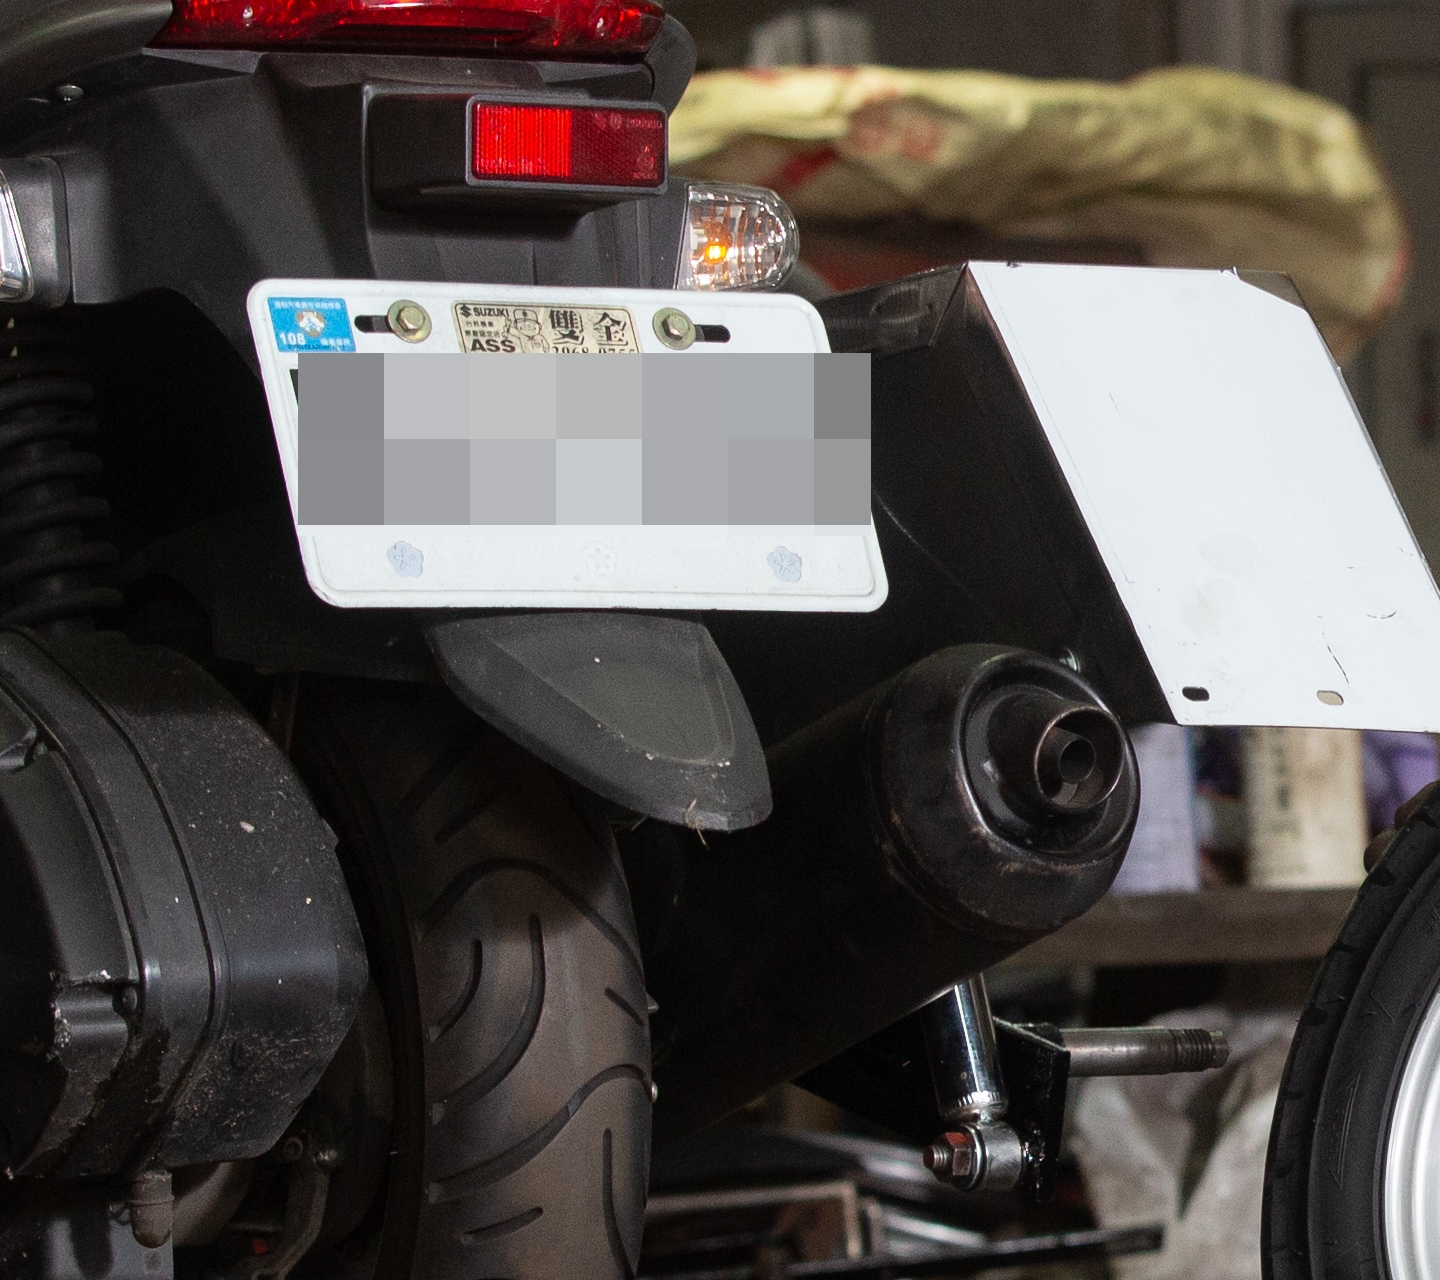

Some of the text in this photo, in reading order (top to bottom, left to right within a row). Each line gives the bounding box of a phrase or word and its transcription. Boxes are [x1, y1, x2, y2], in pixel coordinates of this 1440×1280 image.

[473, 307, 510, 318] SUZUKI
[279, 332, 306, 346] 108
[471, 338, 516, 353] ASS
